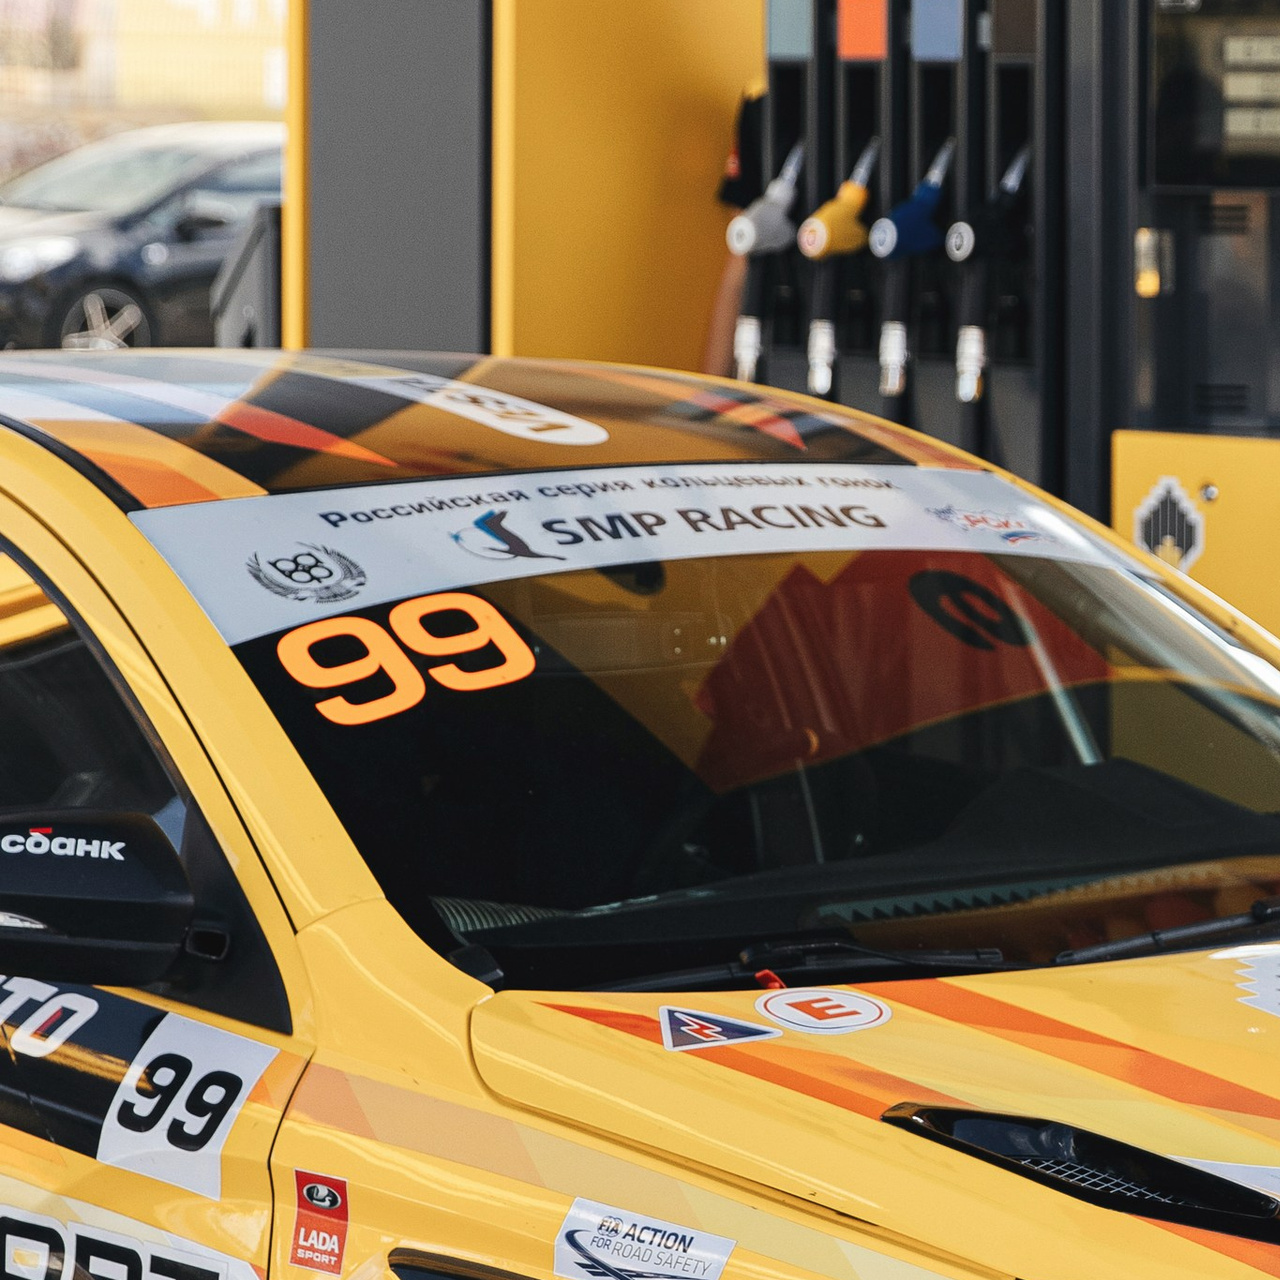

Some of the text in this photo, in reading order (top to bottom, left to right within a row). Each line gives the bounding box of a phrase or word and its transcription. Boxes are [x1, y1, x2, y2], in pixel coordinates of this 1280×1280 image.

[318, 472, 902, 528] Российская серия кольцевых гонок
[541, 510, 668, 546] SMP
[677, 504, 888, 534] RACING
[276, 592, 537, 726] 99
[117, 1053, 243, 1152] 99
[296, 1248, 338, 1266] SPORT
[298, 1226, 340, 1254] LADA
[590, 1236, 713, 1276] FOR ROAD SAFETY
[599, 1219, 695, 1254] FIA ACTION
